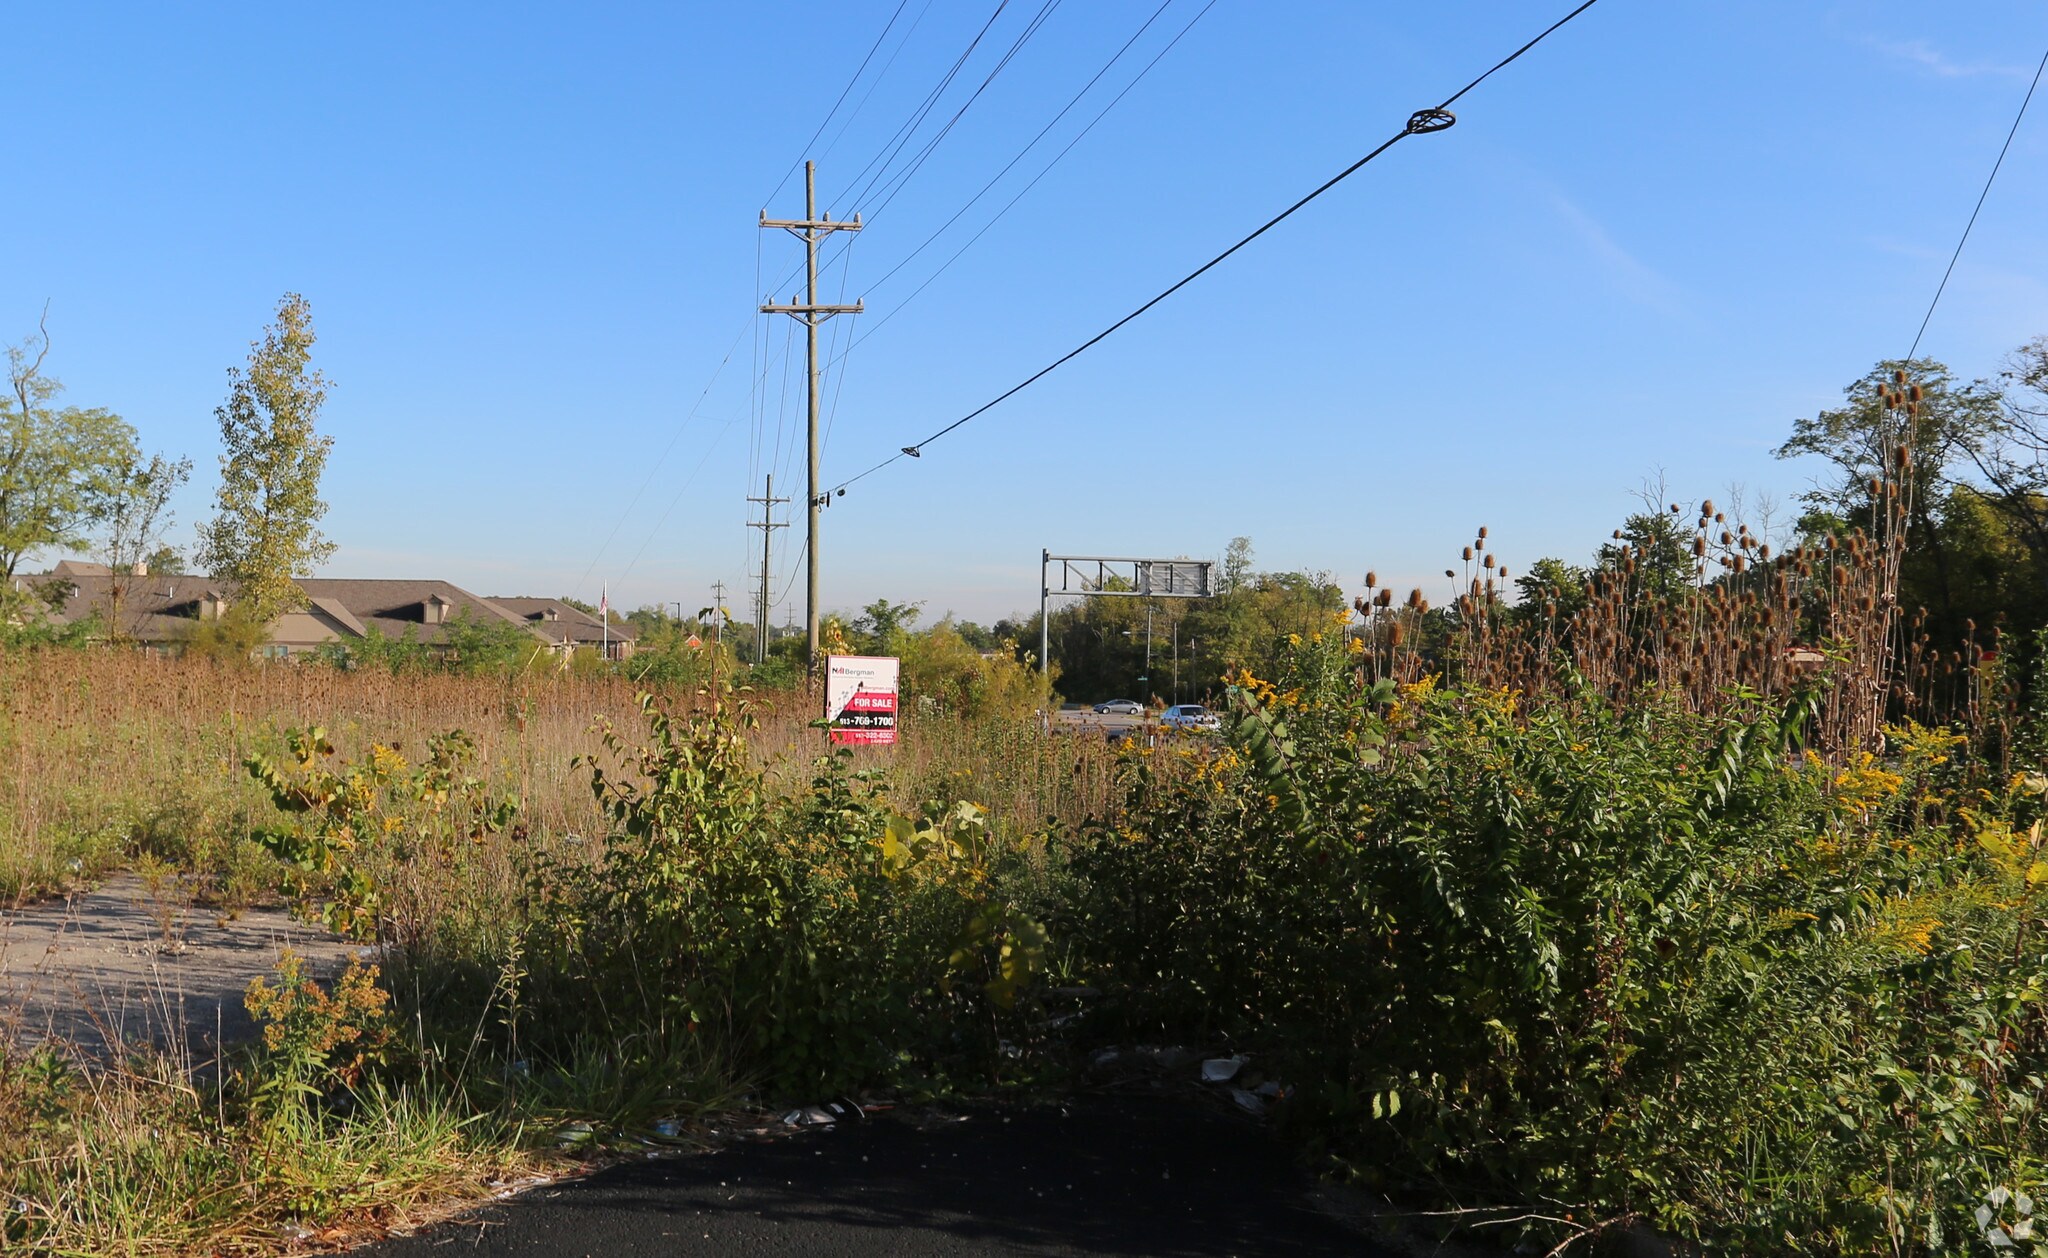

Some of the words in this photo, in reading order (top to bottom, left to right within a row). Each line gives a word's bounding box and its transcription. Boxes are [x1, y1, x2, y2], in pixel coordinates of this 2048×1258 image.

[832, 667, 845, 675] NAI
[854, 698, 870, 707] FOR
[872, 698, 892, 708] SALE
